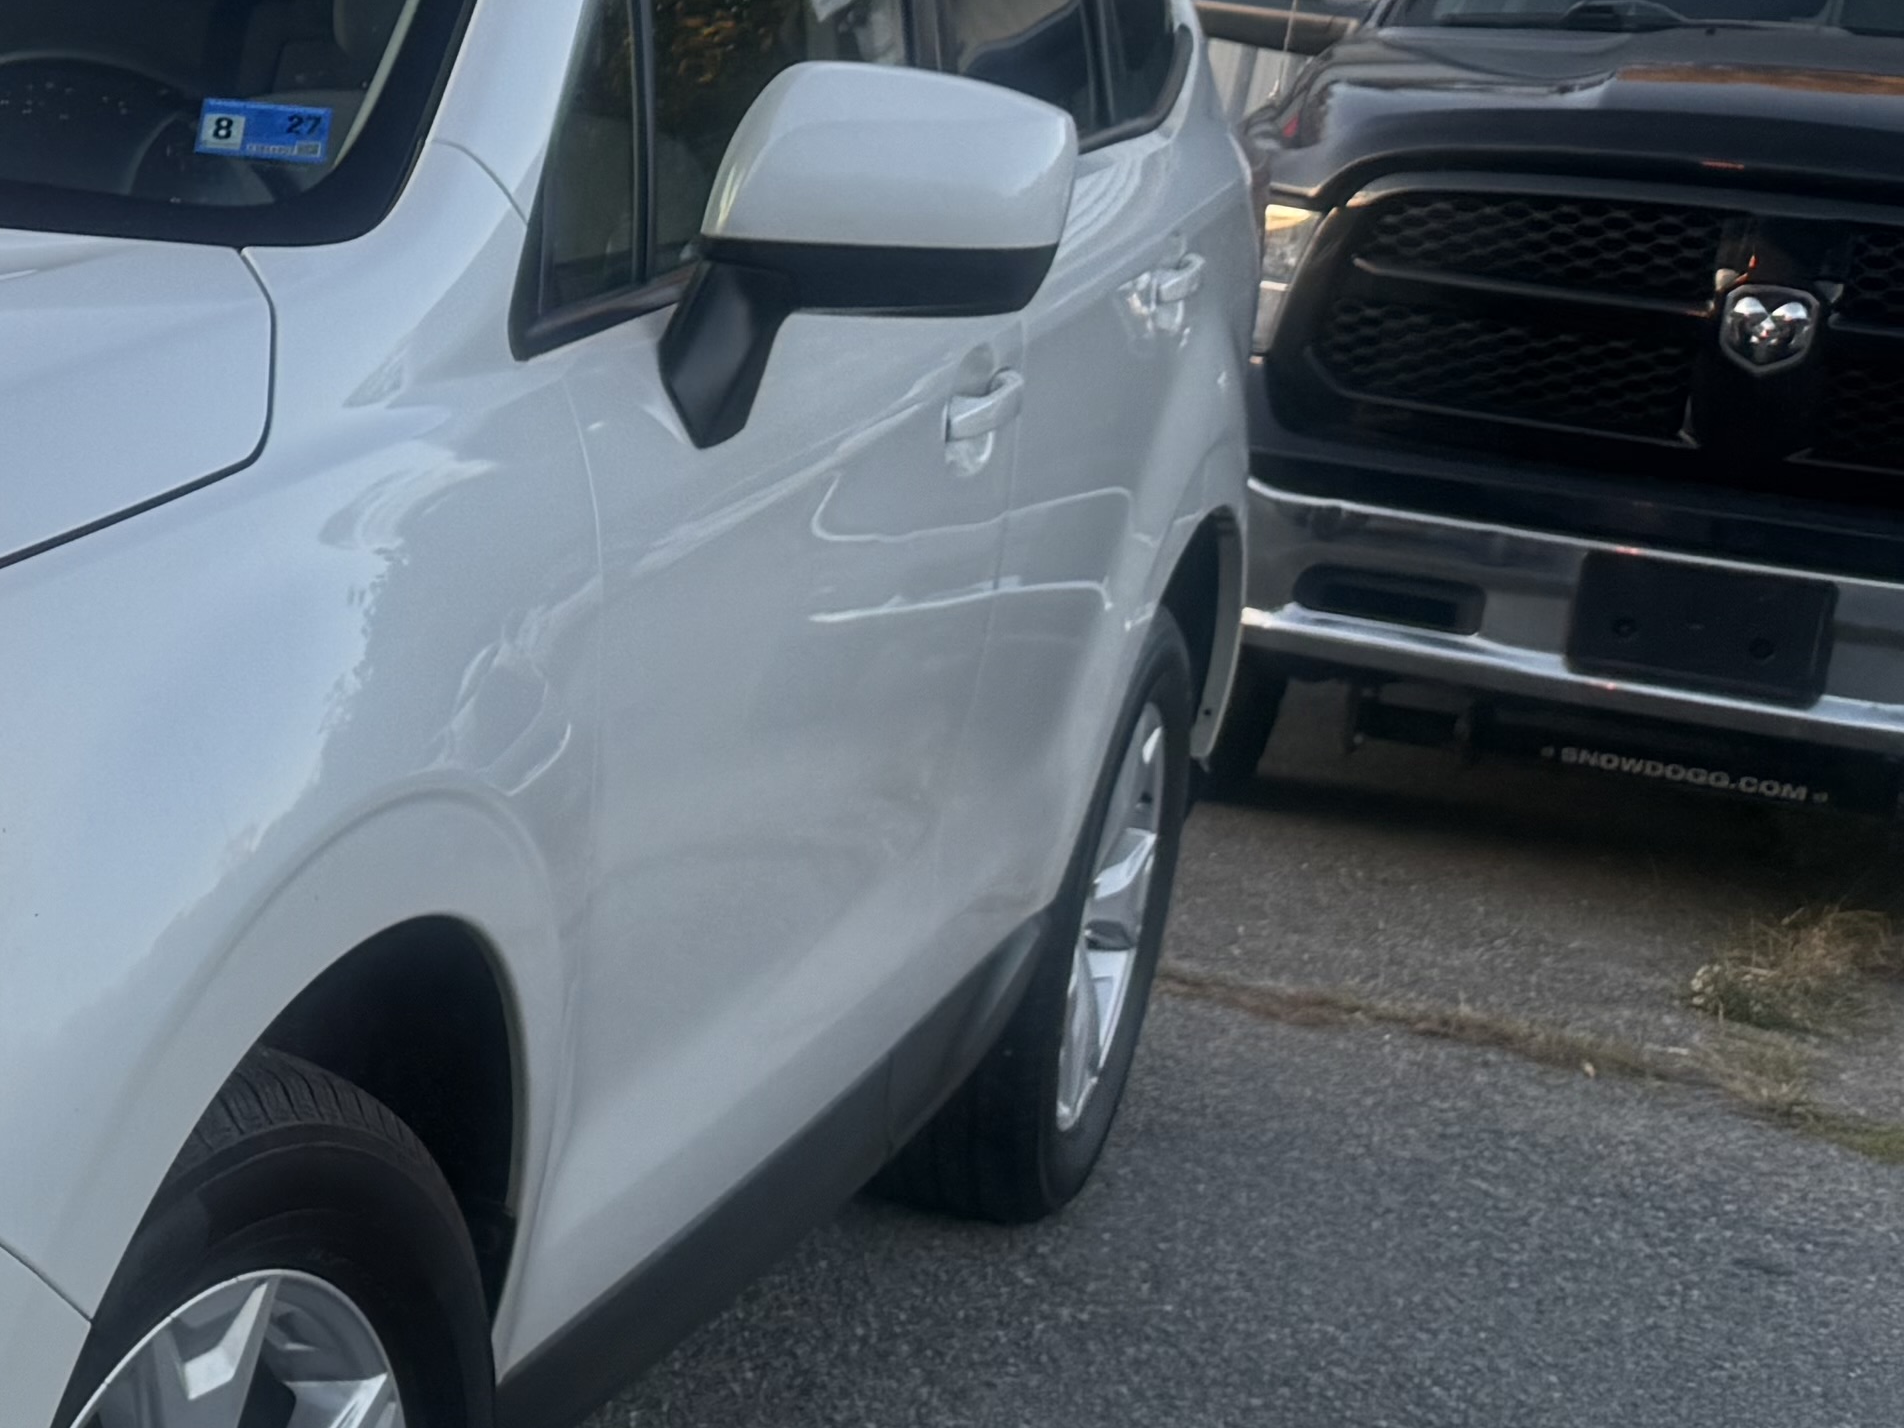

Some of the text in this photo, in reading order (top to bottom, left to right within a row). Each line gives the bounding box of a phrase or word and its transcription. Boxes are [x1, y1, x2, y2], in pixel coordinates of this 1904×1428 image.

[212, 117, 233, 139] 8
[286, 114, 322, 135] 27
[1560, 746, 1808, 802] SNOWDOGG.COM
